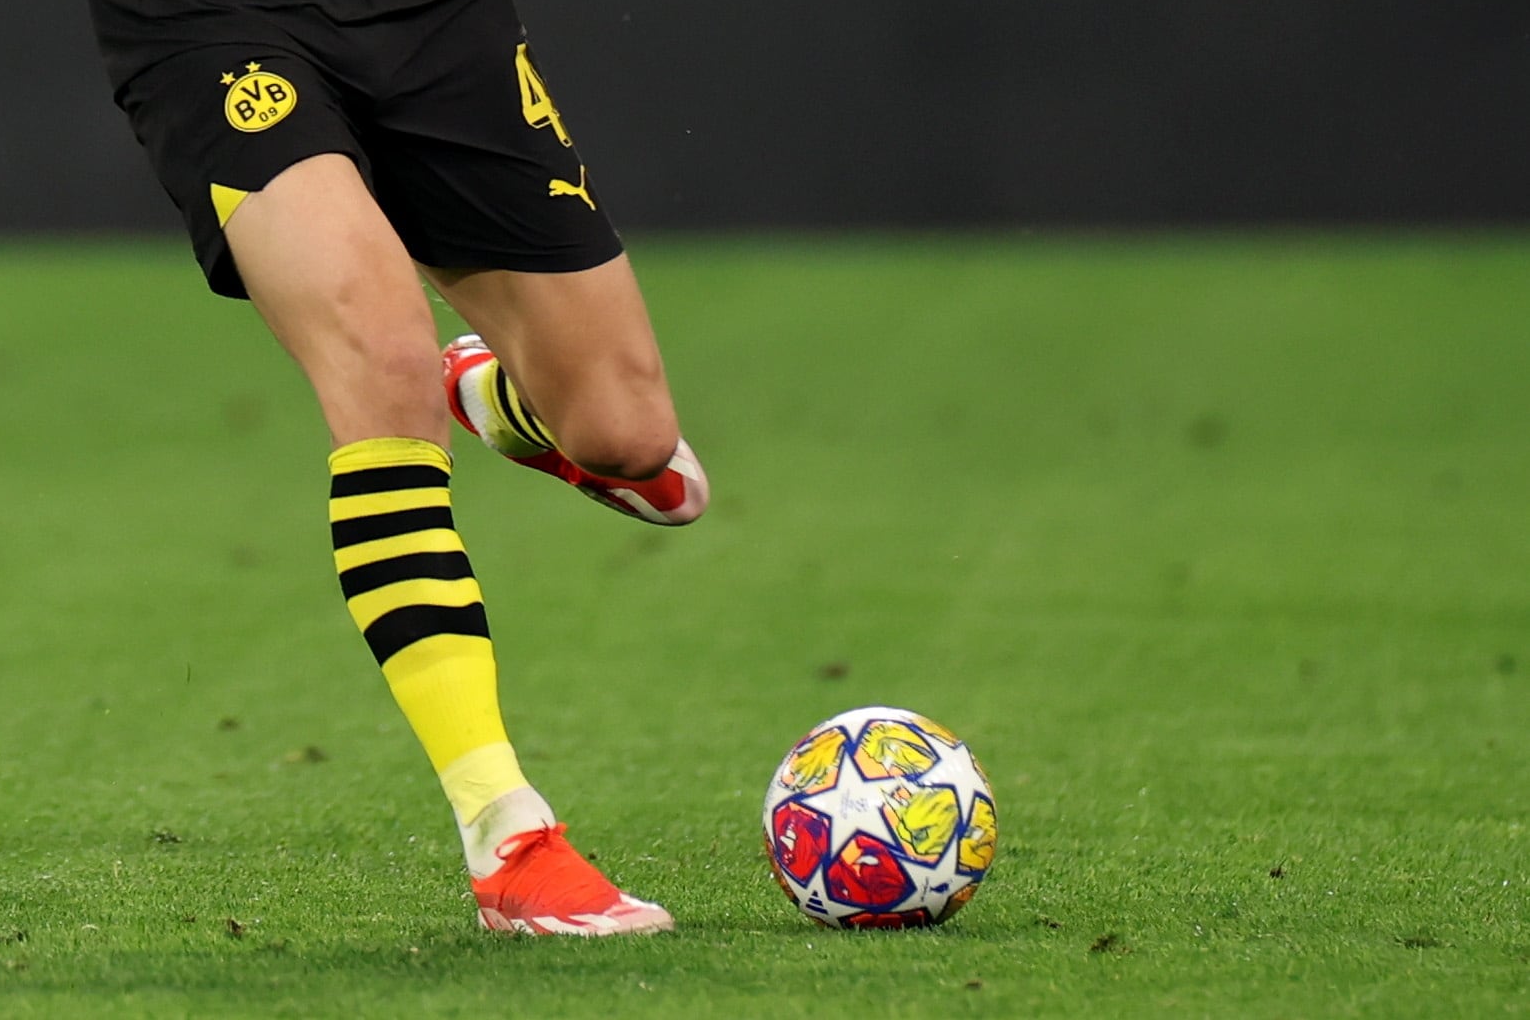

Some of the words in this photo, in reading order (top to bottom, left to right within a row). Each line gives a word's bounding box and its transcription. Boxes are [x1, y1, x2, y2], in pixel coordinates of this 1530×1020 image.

[234, 79, 287, 122] BVB
[258, 106, 278, 122] 09
[515, 43, 573, 148] 4
